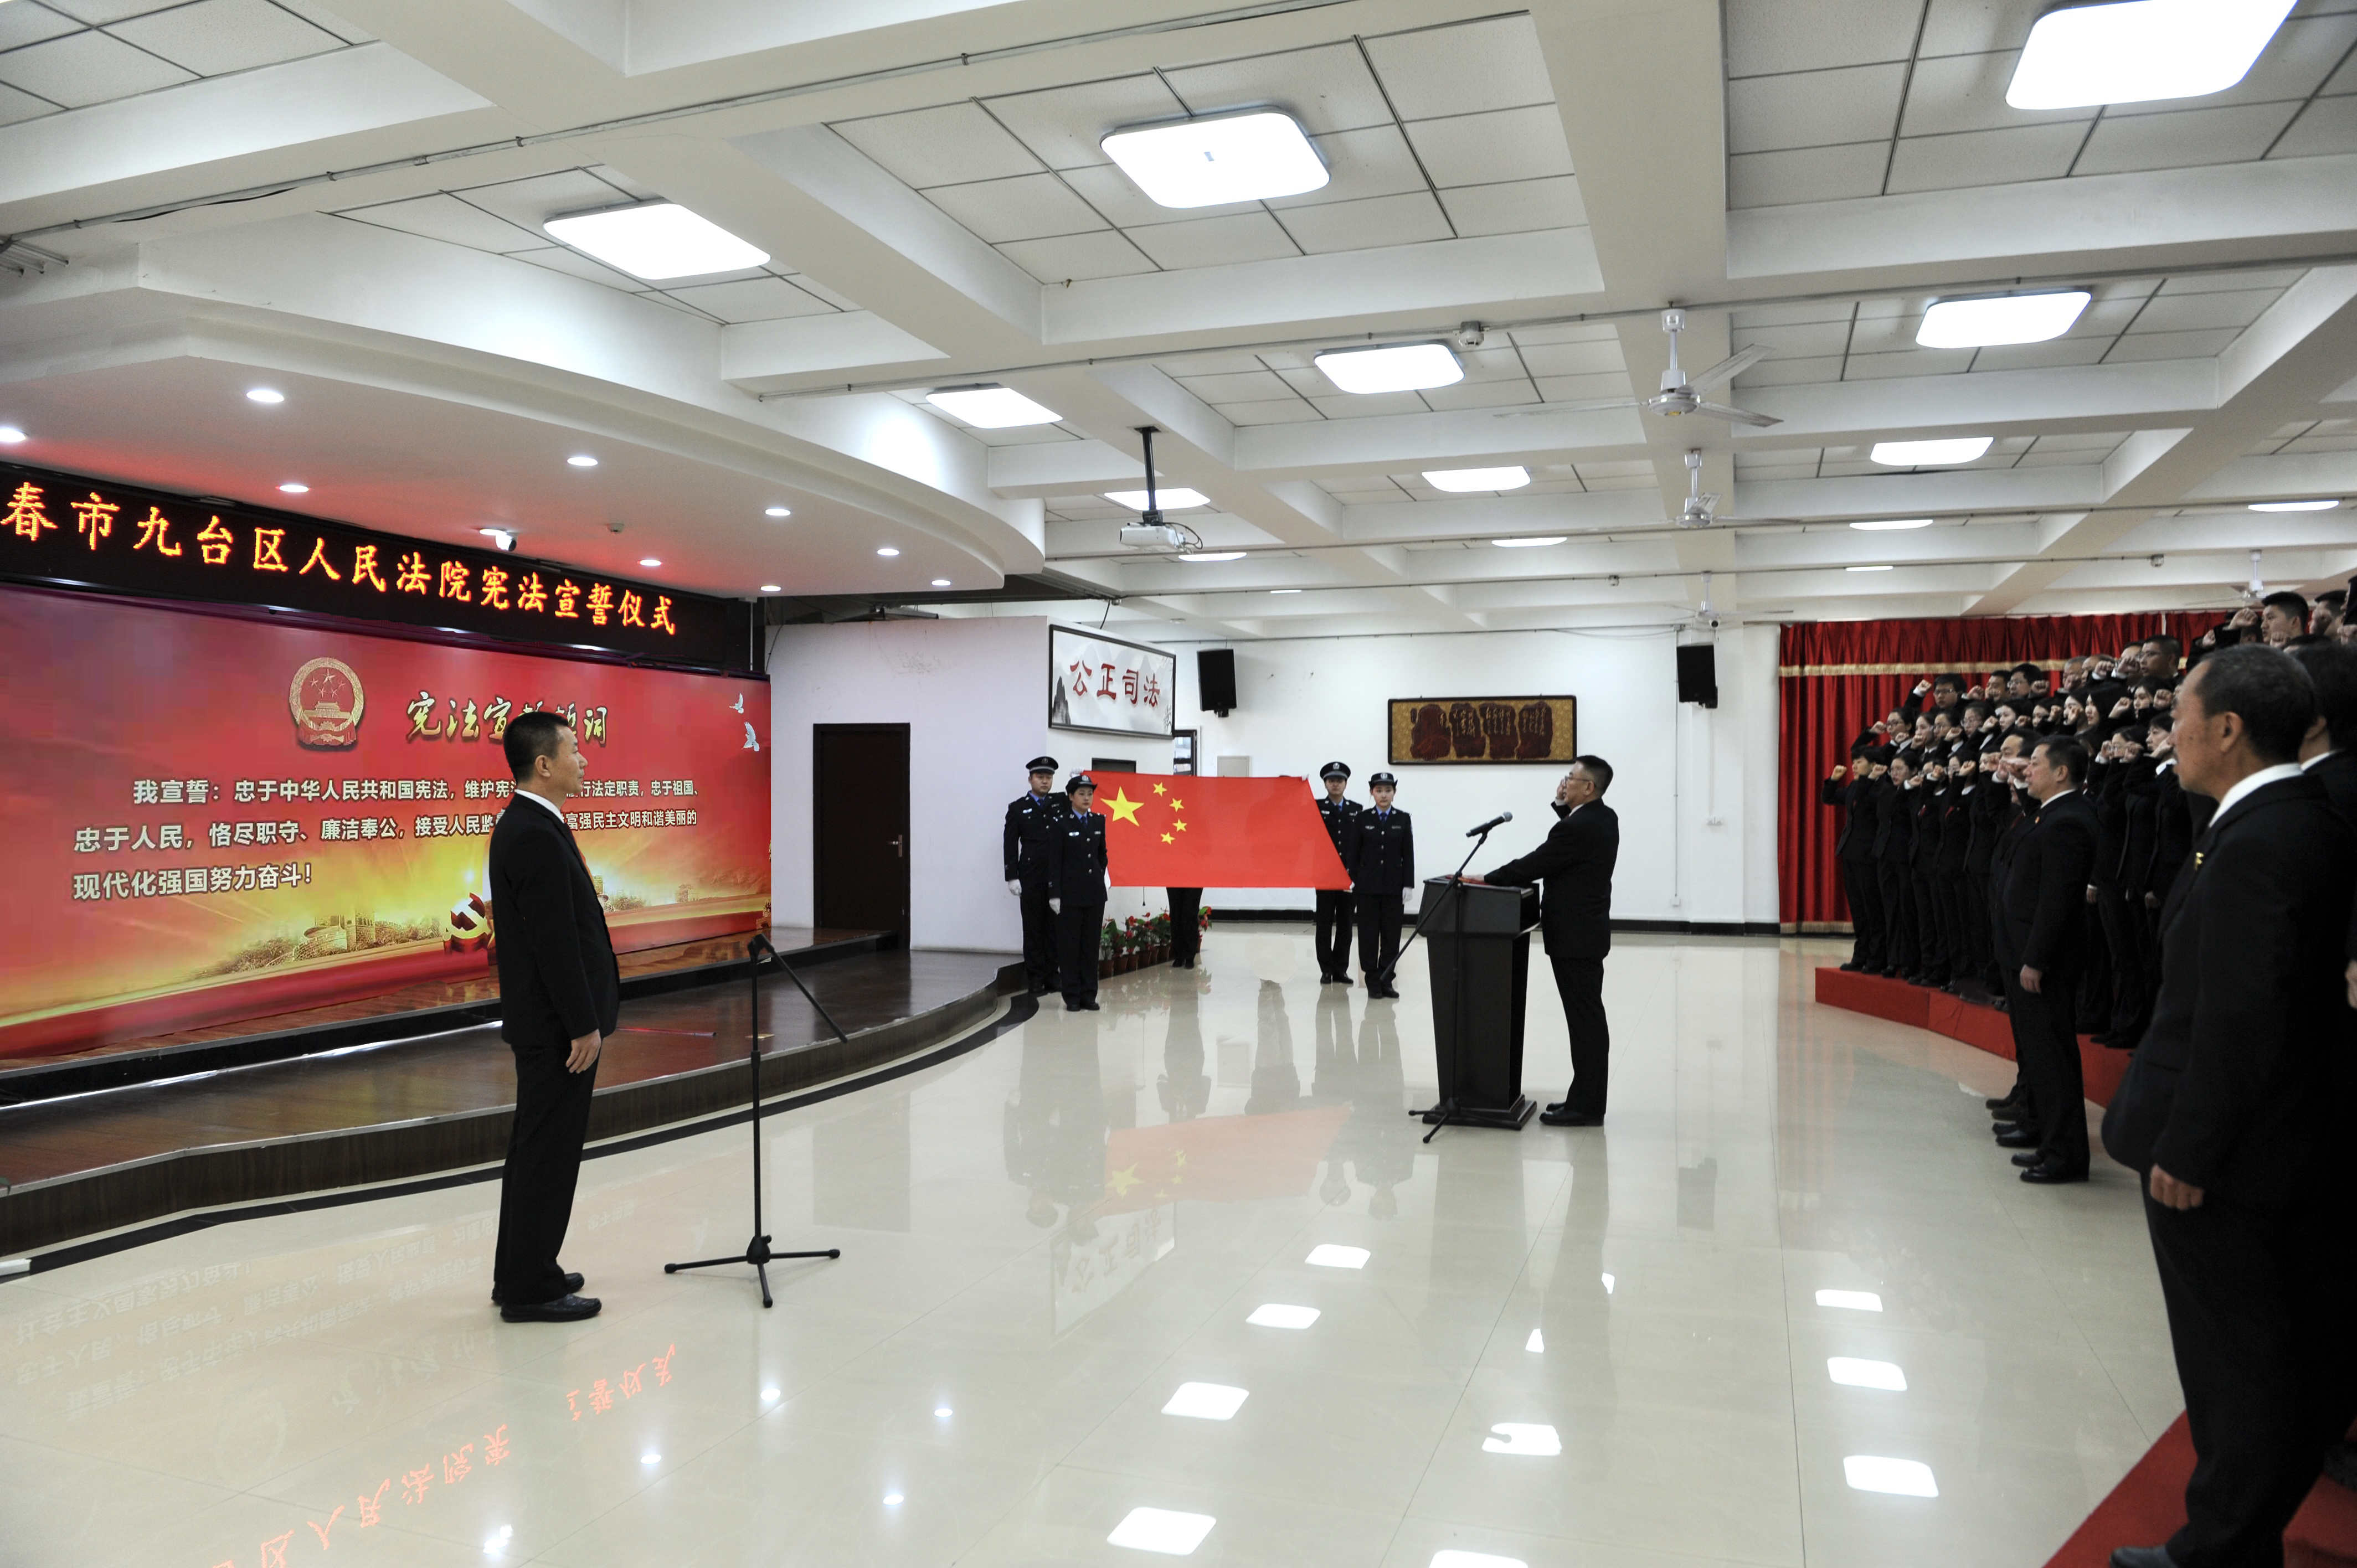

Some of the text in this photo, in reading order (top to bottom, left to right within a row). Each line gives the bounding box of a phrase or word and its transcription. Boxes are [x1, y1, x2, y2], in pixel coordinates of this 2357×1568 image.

[1, 482, 676, 635] 春市九台区人民法院宪法宣誓仪式
[1069, 659, 1160, 708] 公正司法
[406, 691, 608, 744] 宪法宣词
